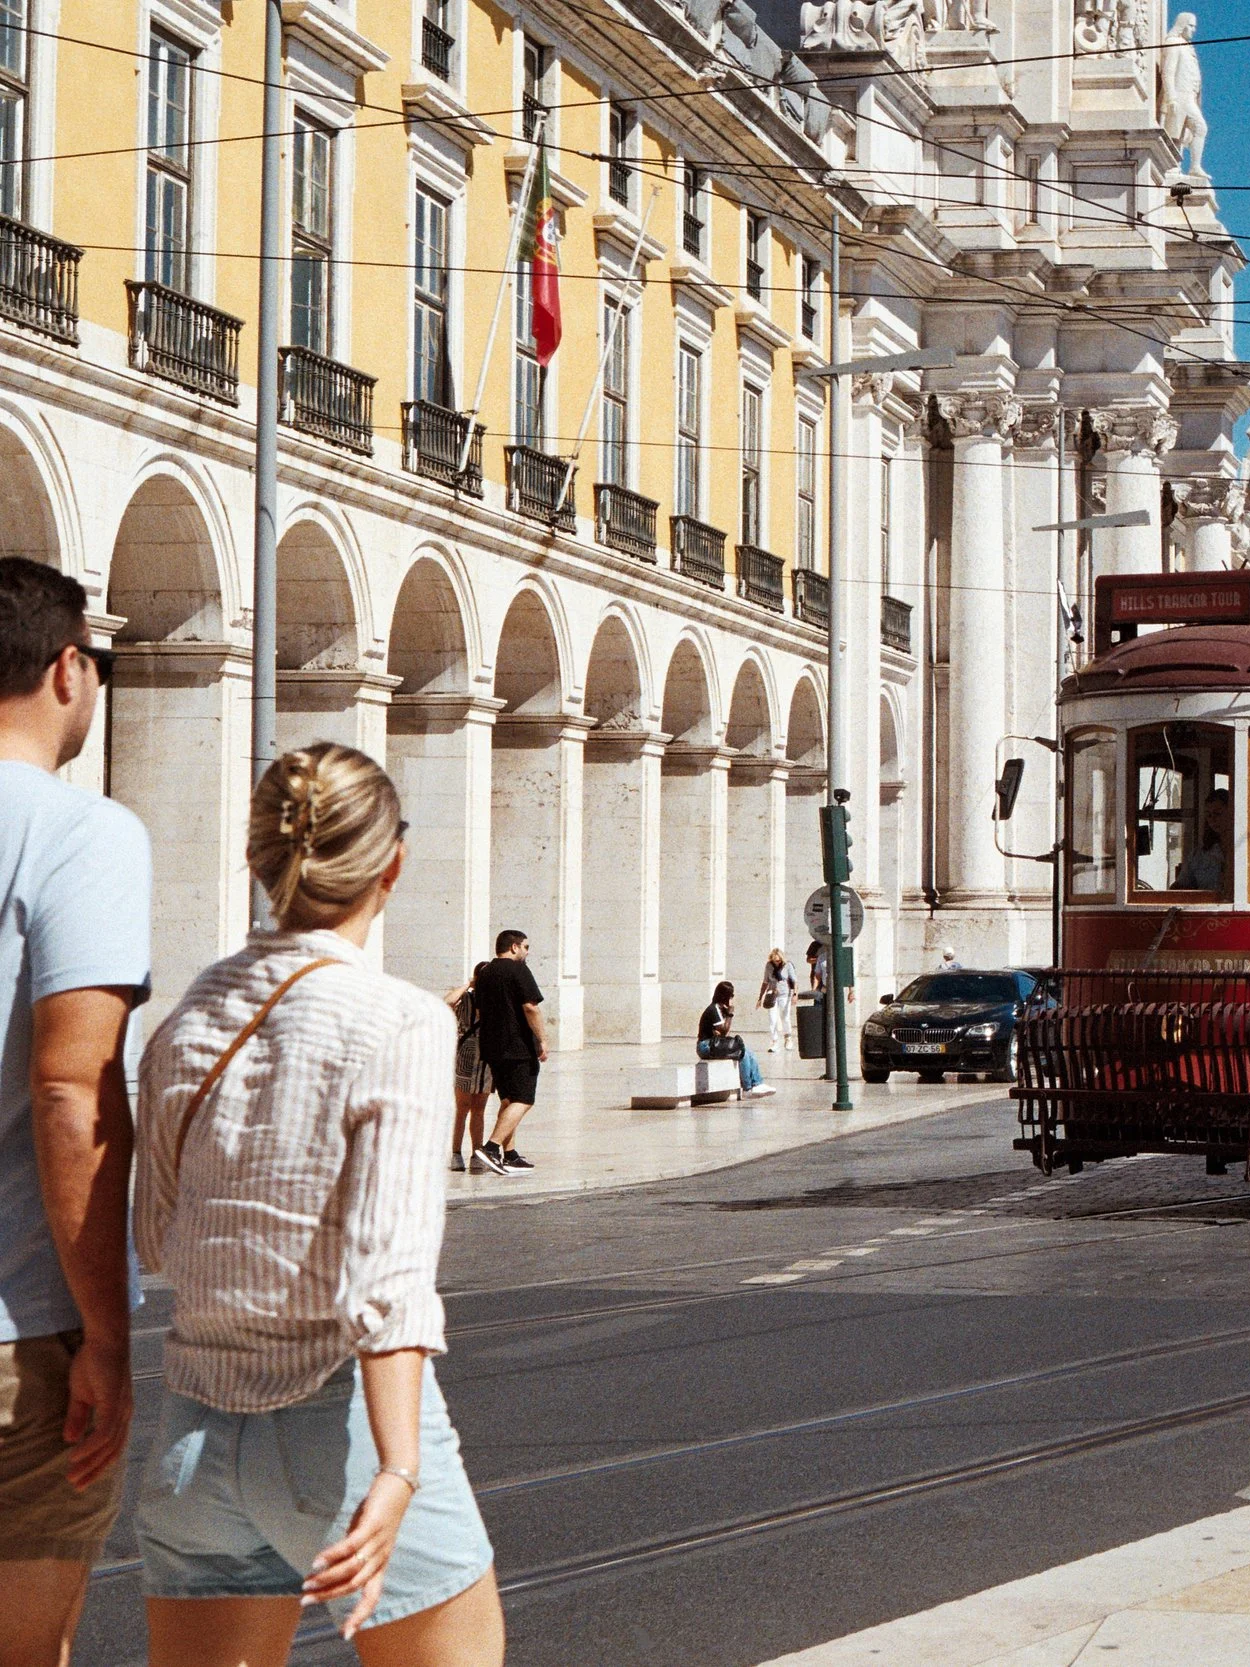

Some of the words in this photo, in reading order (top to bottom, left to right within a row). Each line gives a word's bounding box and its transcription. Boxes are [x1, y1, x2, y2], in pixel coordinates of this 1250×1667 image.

[1120, 594, 1155, 611] HILLS
[1157, 592, 1209, 609] TRAMCAR
[1210, 591, 1241, 607] TOUR
